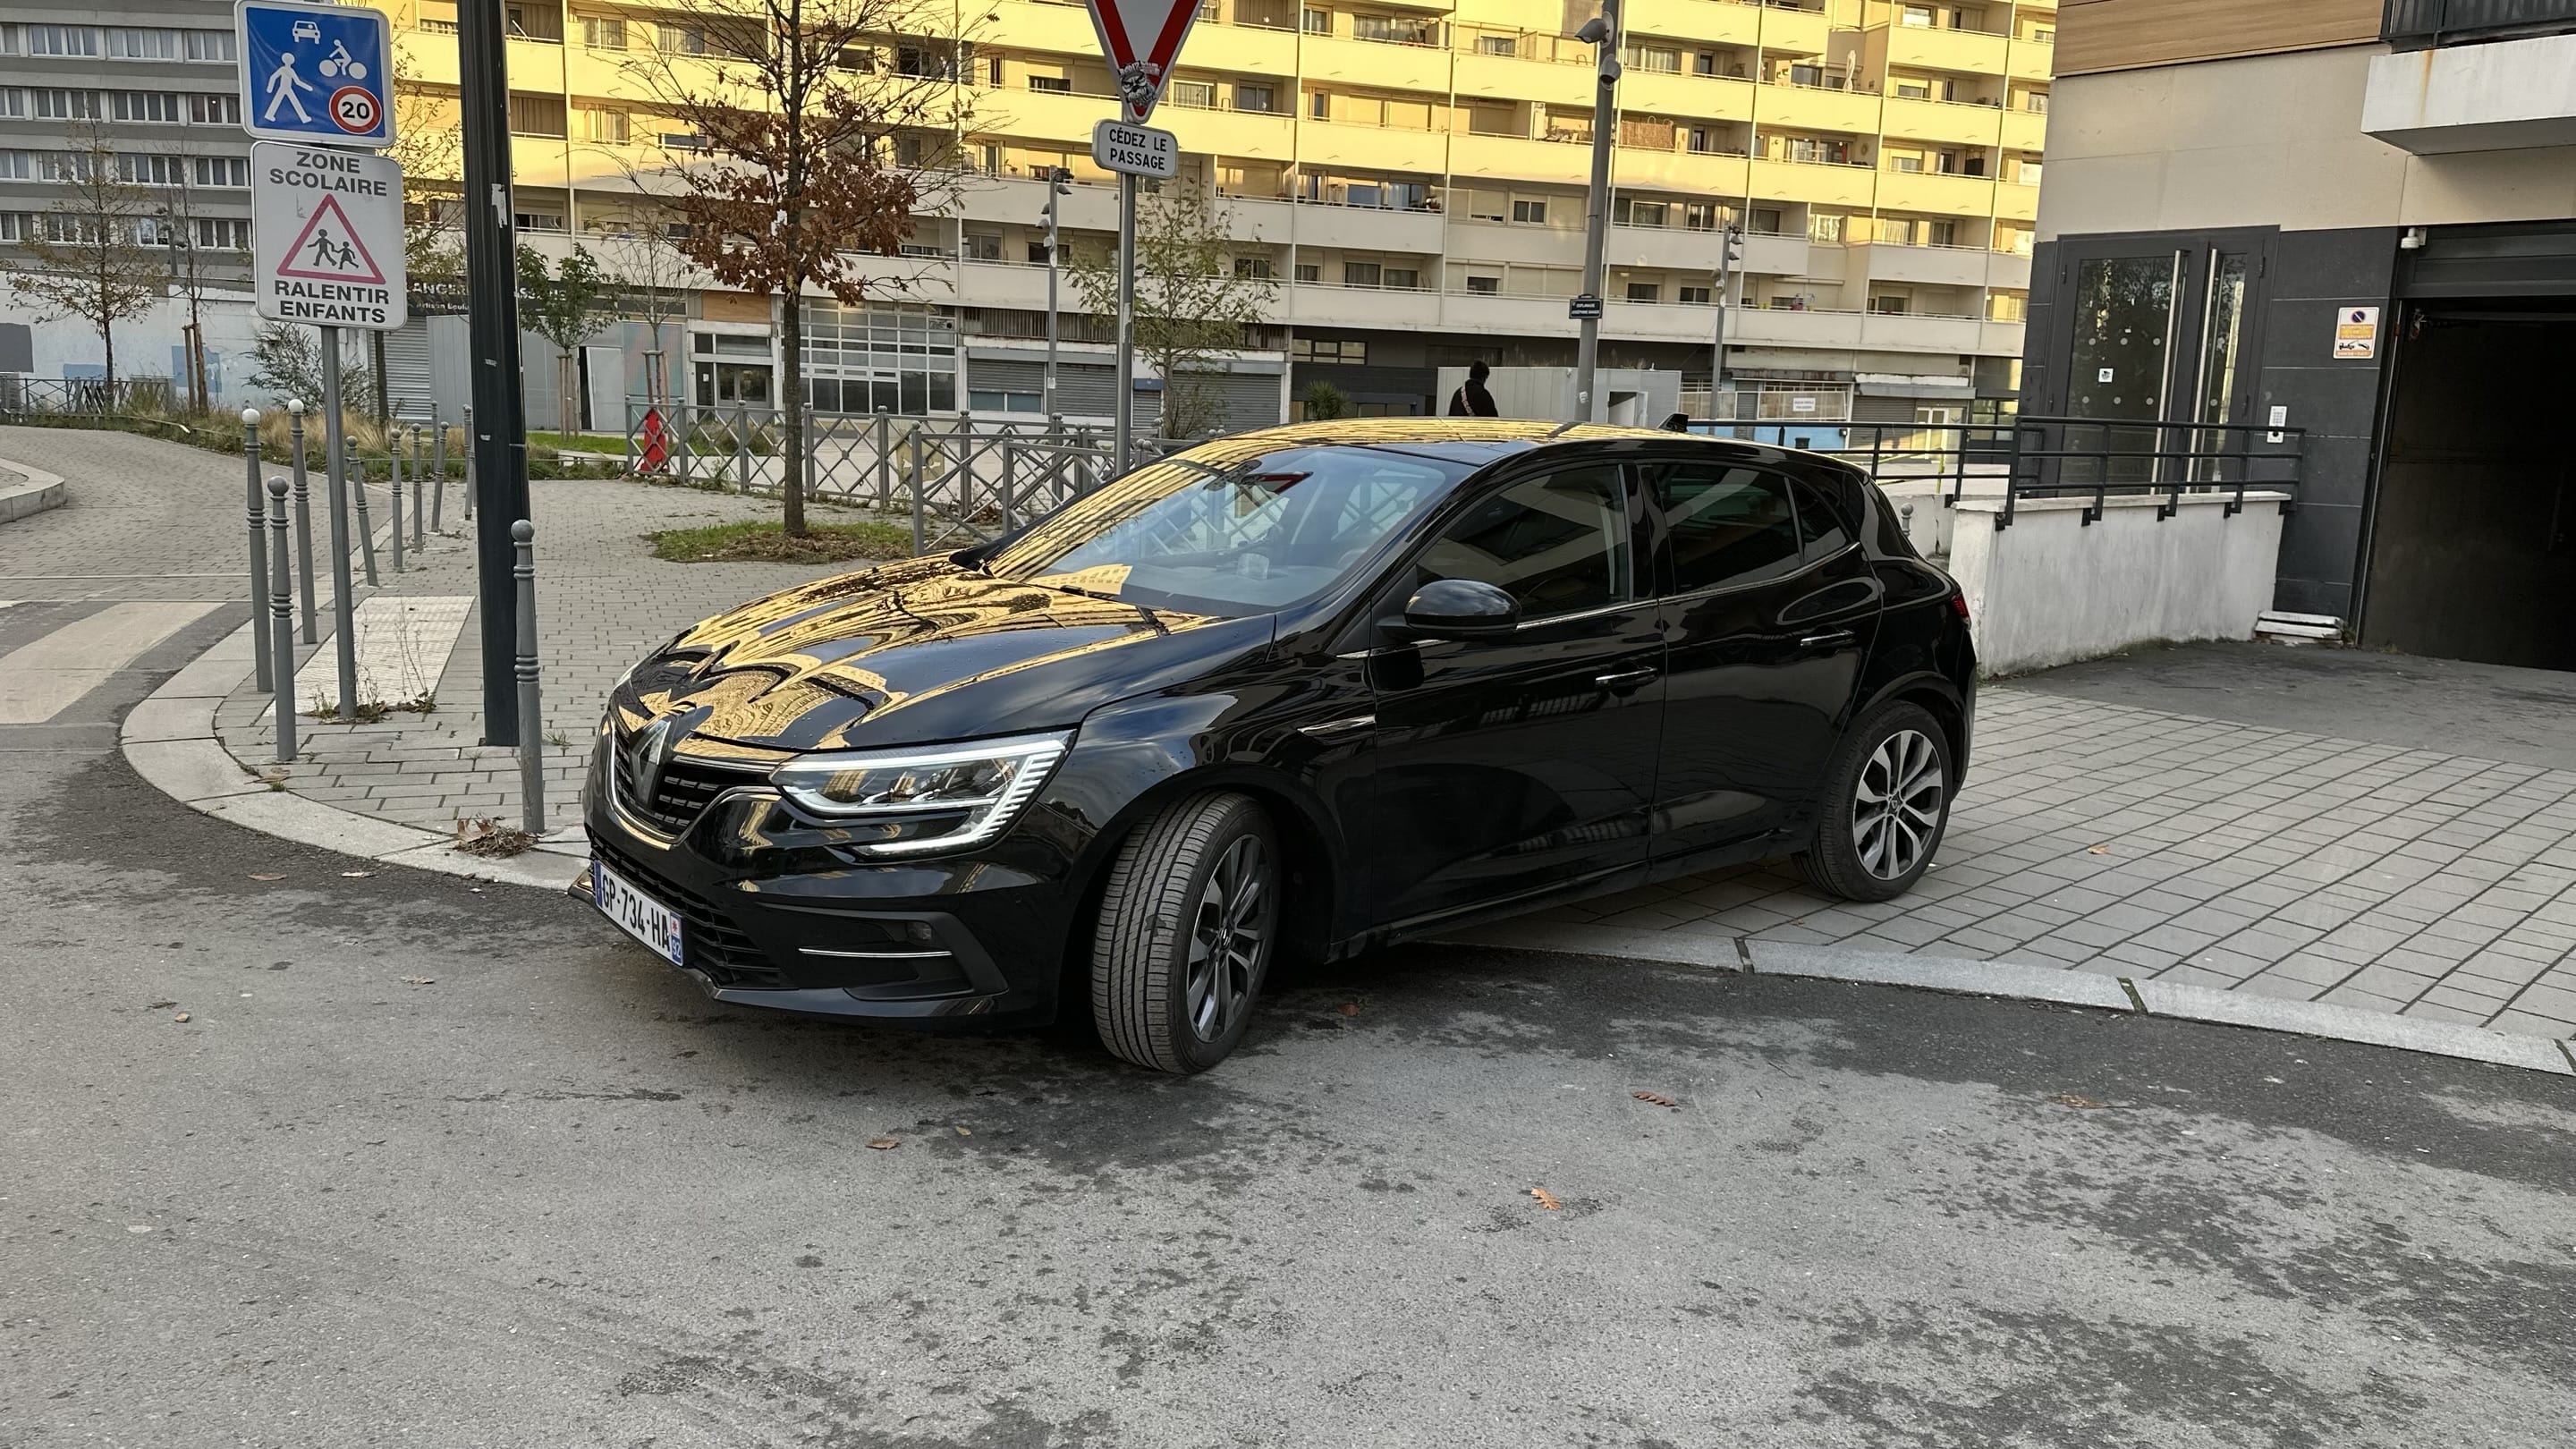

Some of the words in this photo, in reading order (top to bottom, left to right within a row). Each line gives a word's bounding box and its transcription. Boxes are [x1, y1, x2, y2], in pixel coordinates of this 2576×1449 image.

[342, 101, 369, 119] 20
[1109, 127, 1146, 148] CÉDEZ
[1154, 137, 1167, 153] LE
[296, 151, 360, 174] ZONE
[1110, 148, 1165, 171] PASSAGE
[269, 168, 387, 197] SCOLAIRE
[275, 280, 390, 304] RALENTIR
[280, 301, 386, 323] ENFANTS
[602, 874, 671, 953] GP-734-HA
[672, 939, 682, 959] 92
